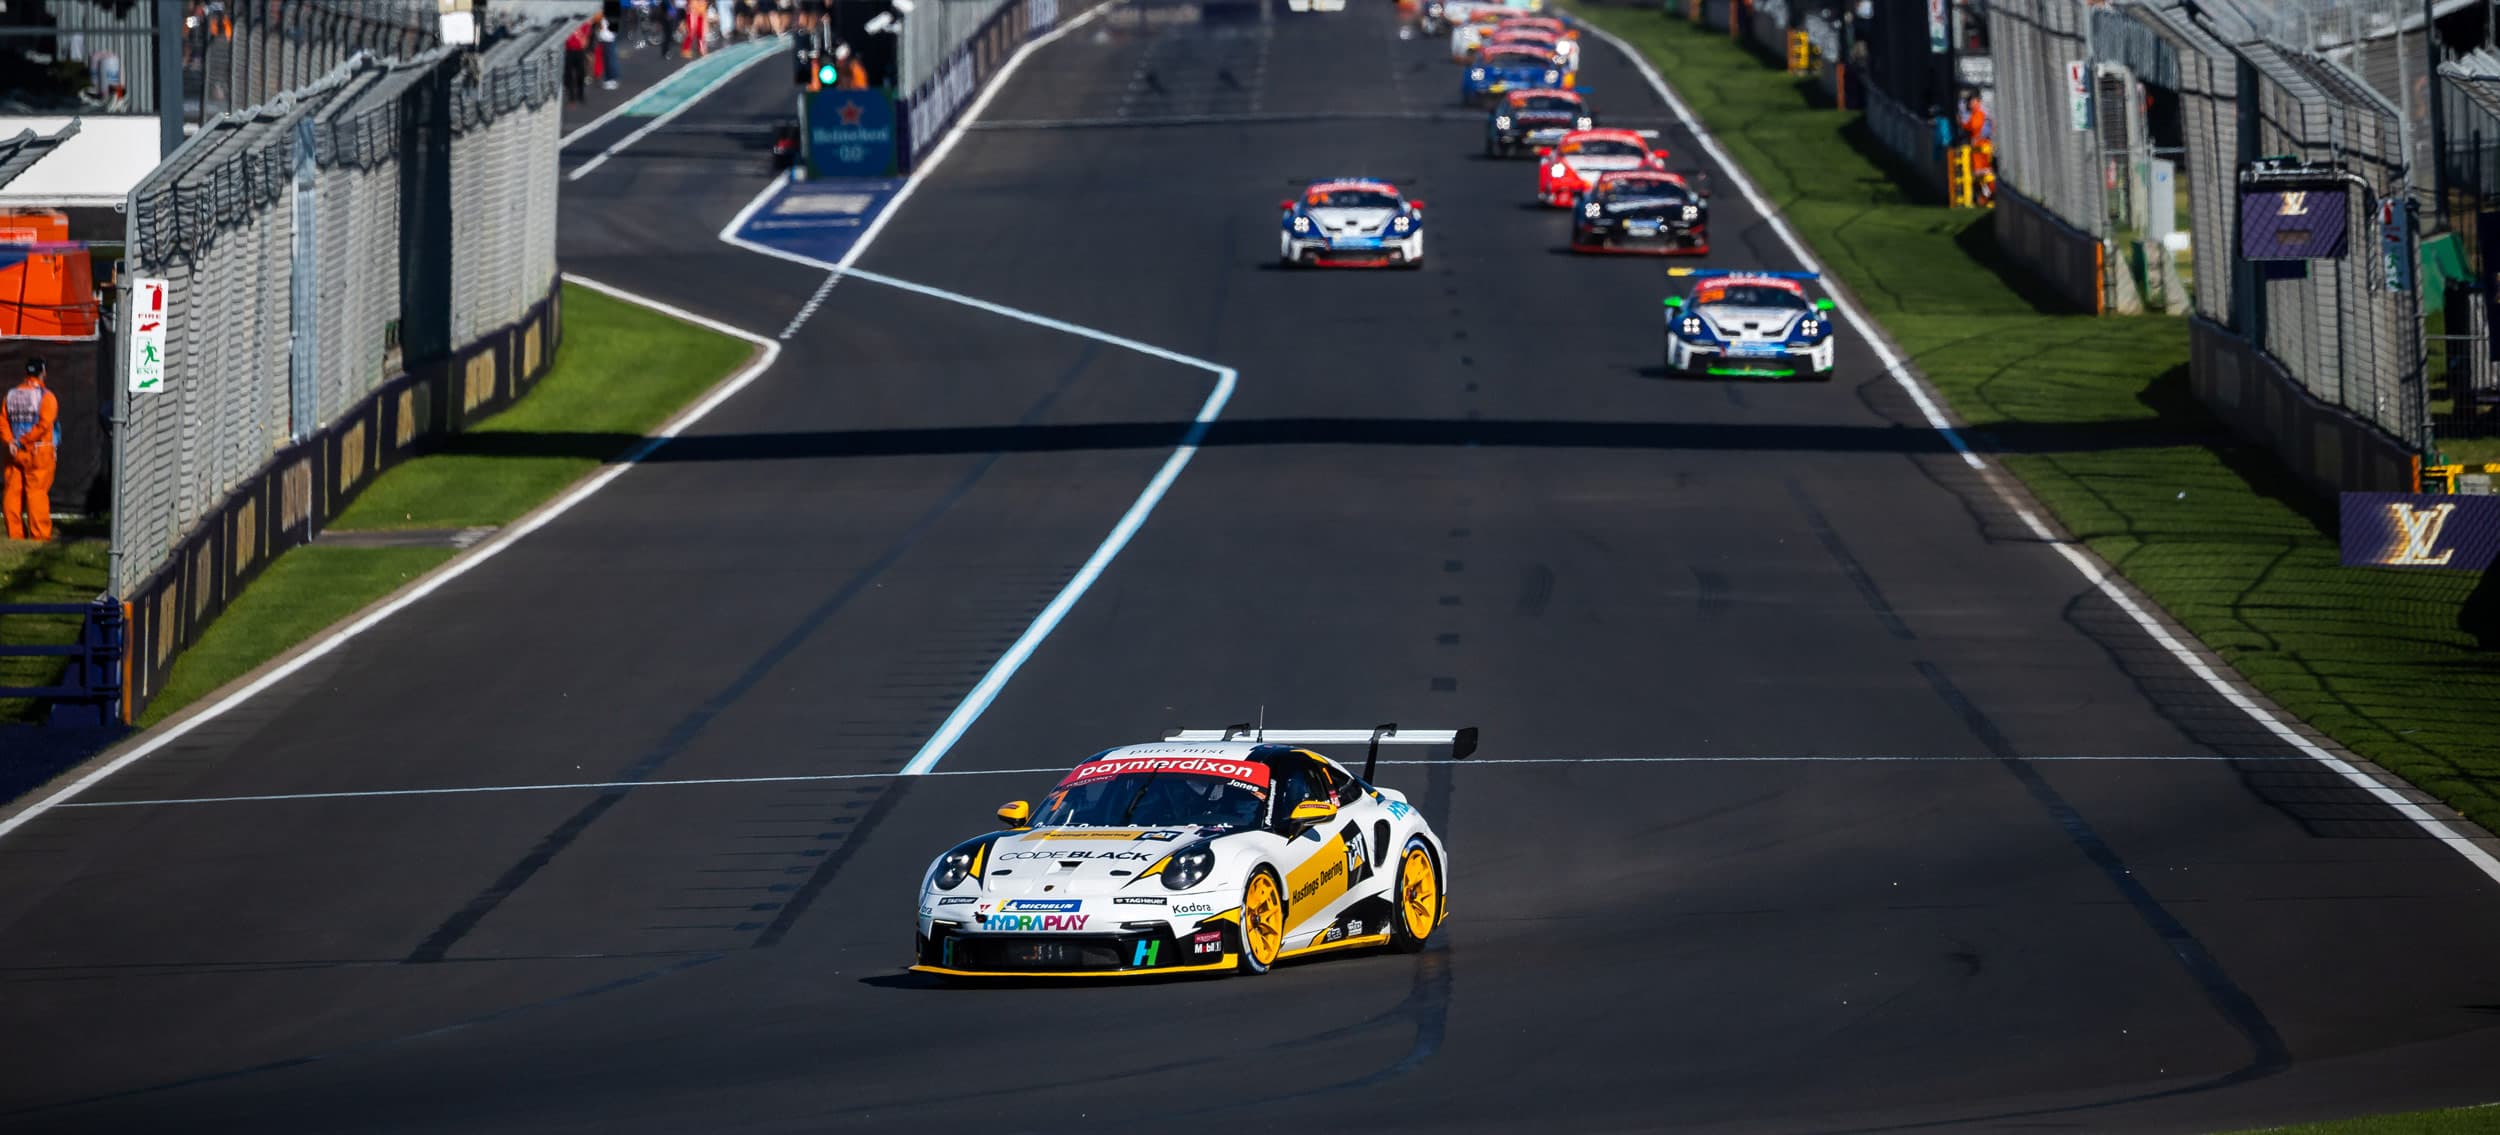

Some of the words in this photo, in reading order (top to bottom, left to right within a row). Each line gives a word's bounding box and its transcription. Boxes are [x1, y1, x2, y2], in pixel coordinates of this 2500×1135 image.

[1077, 758, 1253, 779] paynterdixon
[1227, 779, 1259, 792] Jones
[1292, 878, 1319, 905] Hastings
[1320, 861, 1343, 887] Deering
[1172, 903, 1211, 914] Kodora
[982, 914, 1090, 931] HYDRAPLAY
[1132, 940, 1160, 966] H
